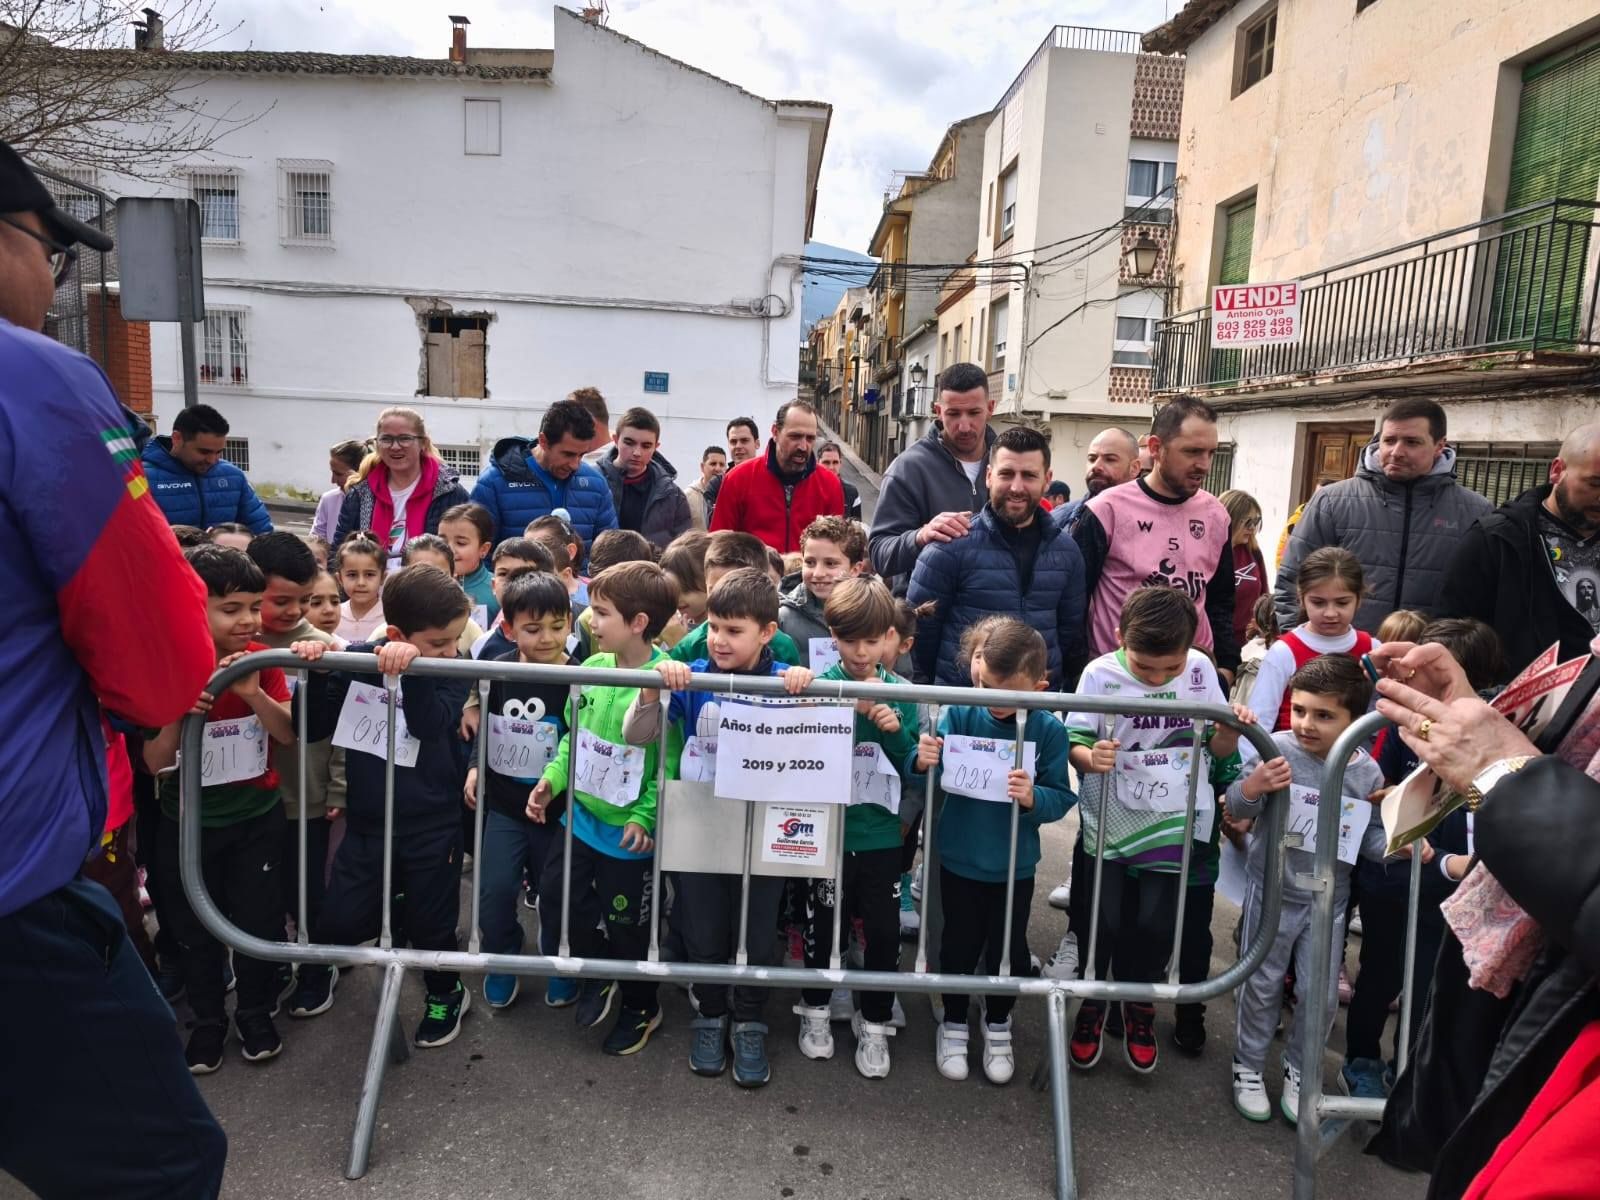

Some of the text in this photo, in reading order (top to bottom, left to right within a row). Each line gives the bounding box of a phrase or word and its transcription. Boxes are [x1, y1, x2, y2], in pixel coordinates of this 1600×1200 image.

[1218, 285, 1295, 309] VENDE
[1227, 308, 1284, 318] Antonio Oya
[1217, 317, 1293, 331] 603 829 499
[1217, 326, 1293, 340] 647 205 949
[1168, 537, 1180, 551] 5
[720, 717, 852, 735] Años de nacimiento
[1133, 714, 1161, 730] SAN
[742, 758, 825, 772] 2019 y 2020
[1132, 781, 1170, 800] 075
